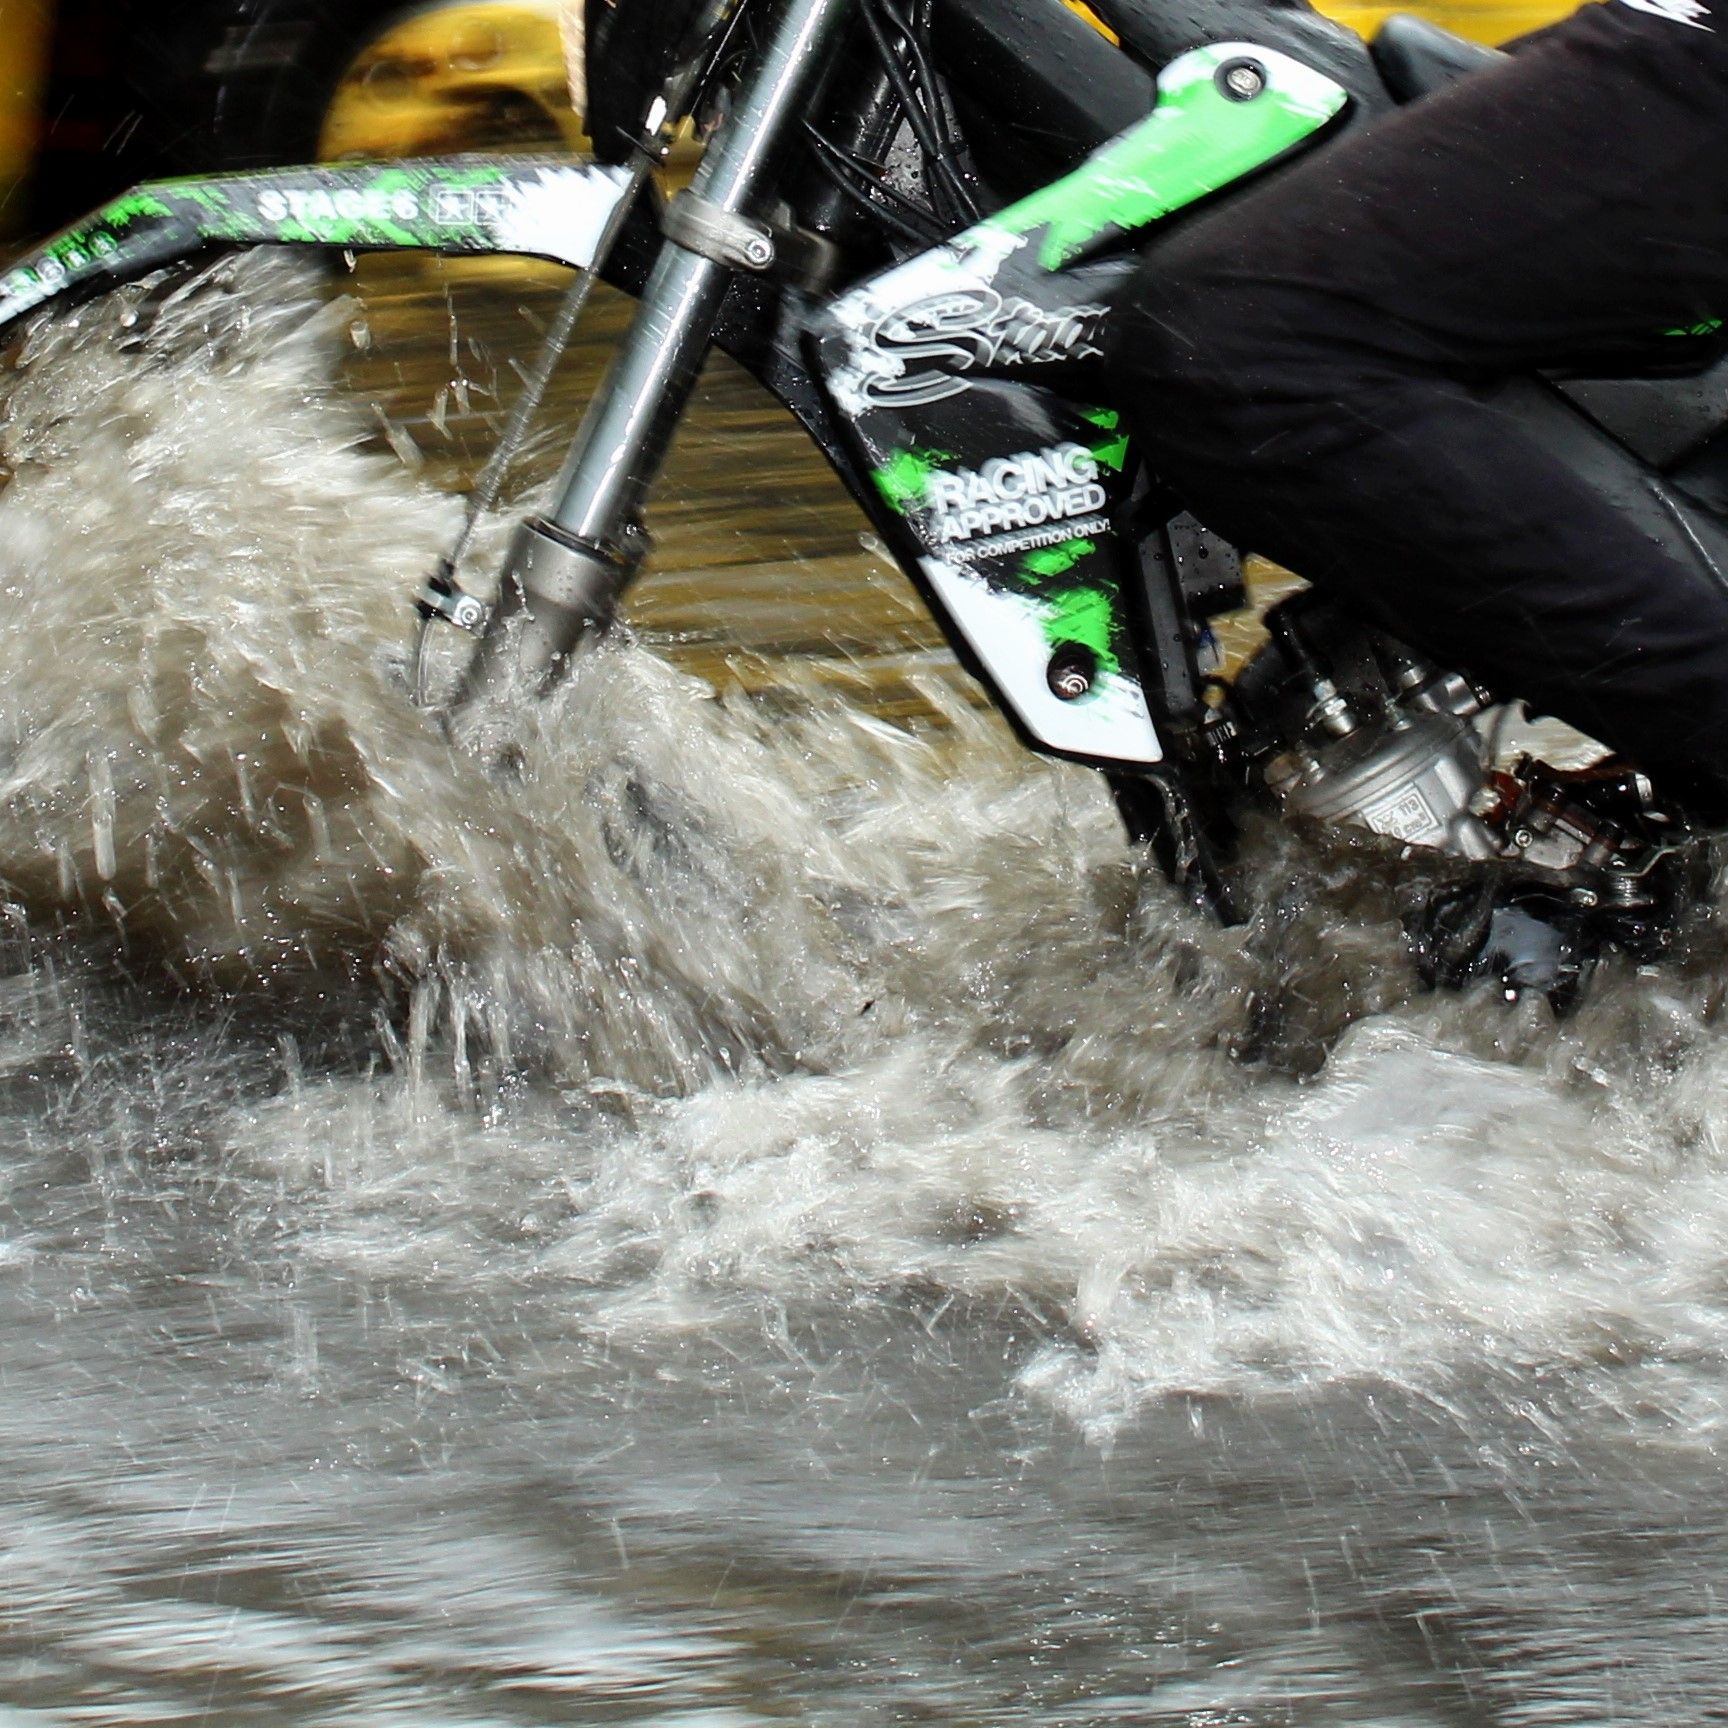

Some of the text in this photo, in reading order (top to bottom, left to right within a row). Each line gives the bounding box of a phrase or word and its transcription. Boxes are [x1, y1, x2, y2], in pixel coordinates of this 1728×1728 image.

[257, 189, 419, 223] STAGE6
[934, 443, 1099, 515] RACING
[936, 483, 1106, 544] APPROVED
[976, 528, 1073, 560] COMPETITION
[1073, 517, 1112, 539] ONLY!
